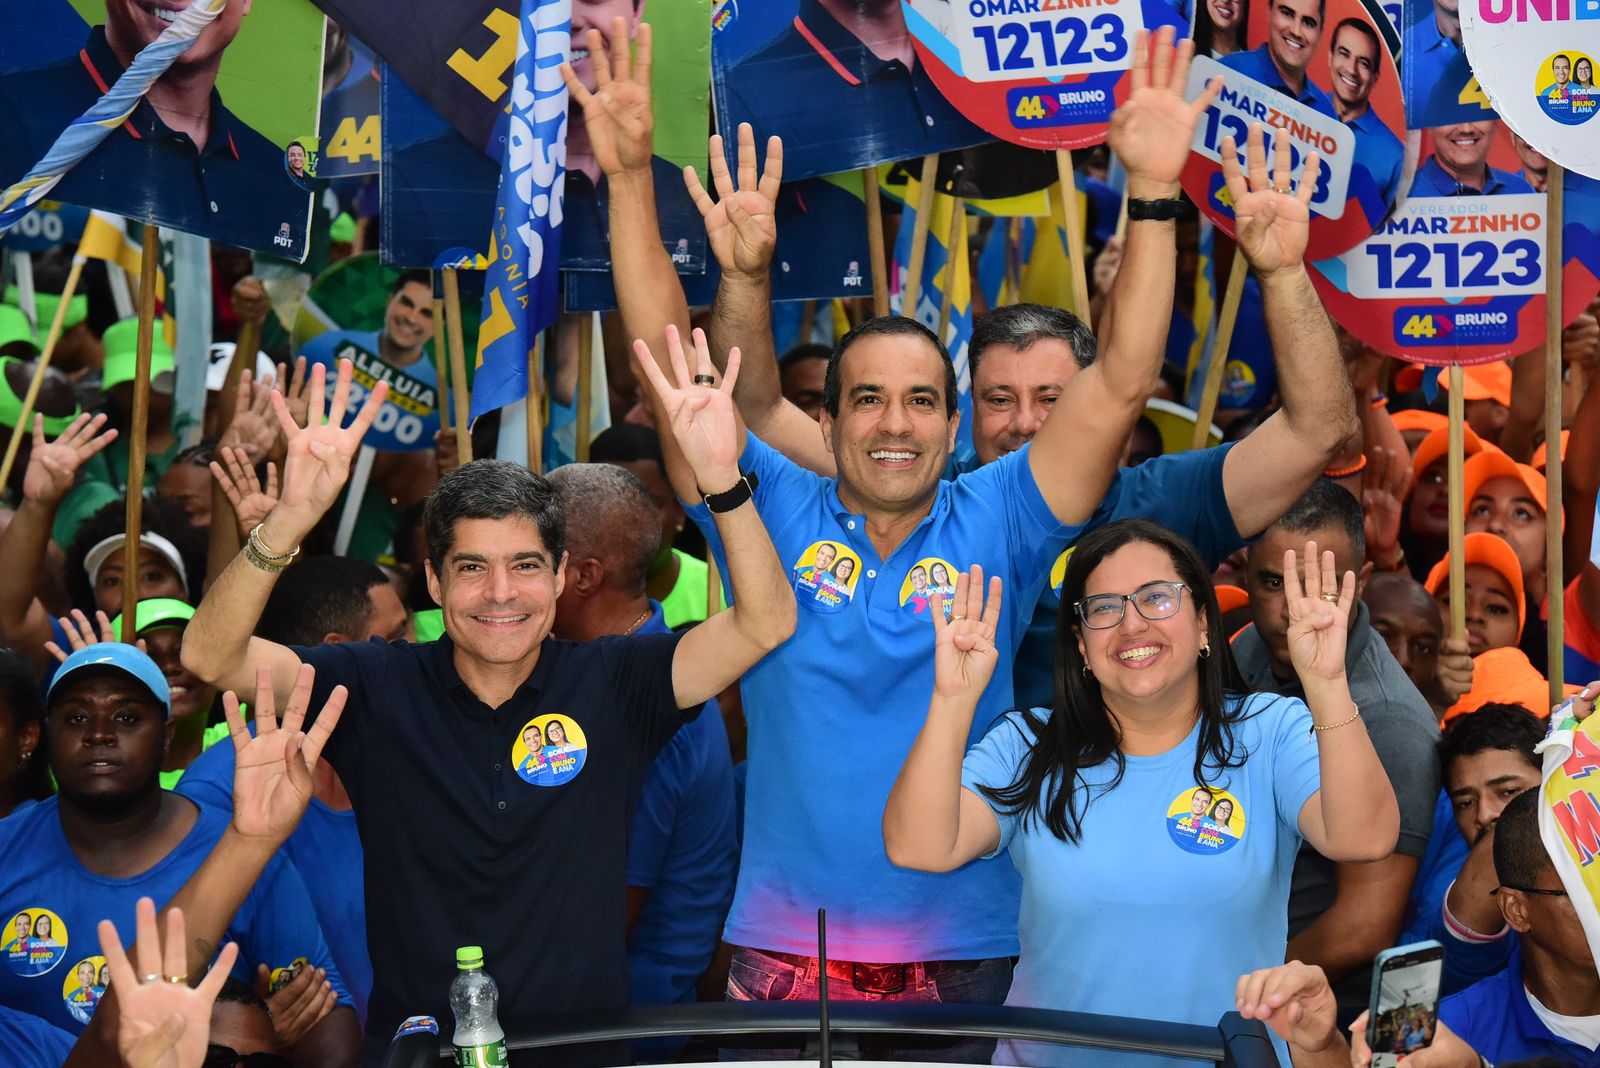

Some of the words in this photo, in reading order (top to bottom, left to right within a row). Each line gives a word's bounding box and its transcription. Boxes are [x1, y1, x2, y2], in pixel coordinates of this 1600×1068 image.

[972, 13, 1129, 72] 12123
[1016, 96, 1046, 120] 44
[1058, 89, 1106, 105] BRUNO
[325, 115, 380, 164] 44
[1409, 203, 1490, 215] VEREADOR
[273, 235, 294, 248] PDT
[672, 254, 691, 264] PDT
[1366, 238, 1542, 289] 12123
[843, 276, 863, 287] PDT
[1402, 314, 1437, 338] 44
[1455, 312, 1508, 326] BRUNO
[338, 345, 435, 407] ALELUIA
[1199, 832, 1226, 845] BRUNO
